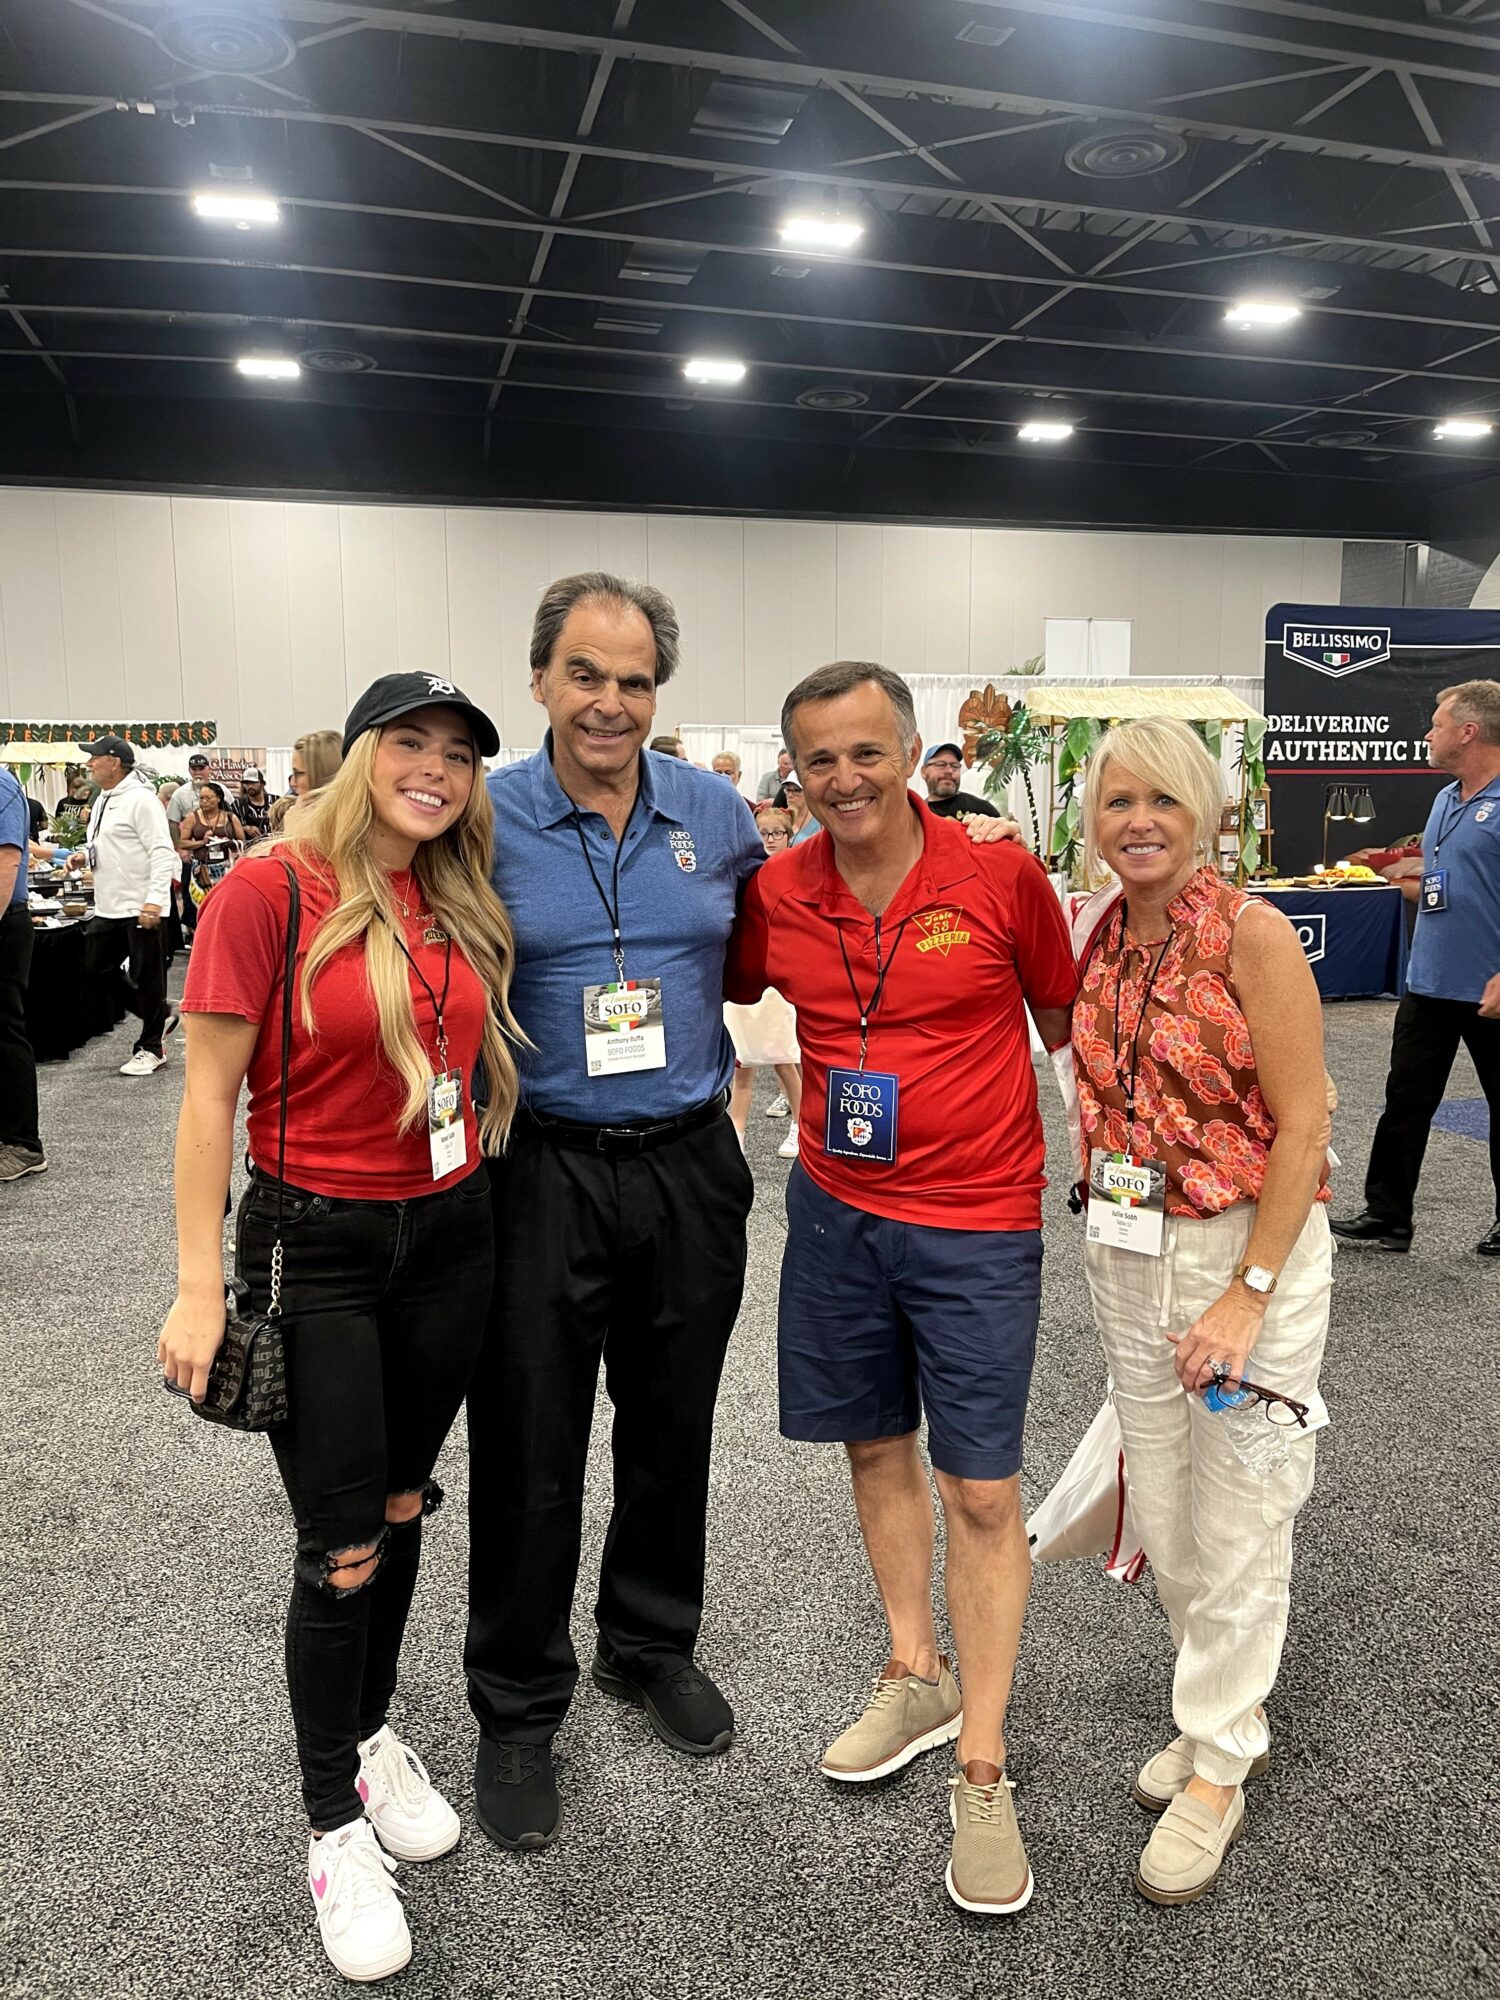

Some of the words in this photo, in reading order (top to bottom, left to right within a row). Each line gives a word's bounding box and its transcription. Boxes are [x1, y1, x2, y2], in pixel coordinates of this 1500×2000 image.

[1292, 631, 1382, 651] BELLISSIMO
[1267, 714, 1390, 734] DELIVERING
[1266, 740, 1408, 761] AUTHENTIC
[669, 831, 690, 840] SOFO
[670, 840, 695, 849] FOODS
[924, 912, 954, 926] Table
[932, 920, 949, 934] 53
[919, 933, 968, 951] PIZZERIA
[604, 1002, 642, 1016] SOFO
[607, 1047, 624, 1056] SOFO
[625, 1044, 645, 1053] FOODS
[842, 1082, 881, 1100] SOFO
[437, 1094, 455, 1112] SOFO
[840, 1098, 883, 1118] FOODS
[1108, 1174, 1145, 1191] SOFO
